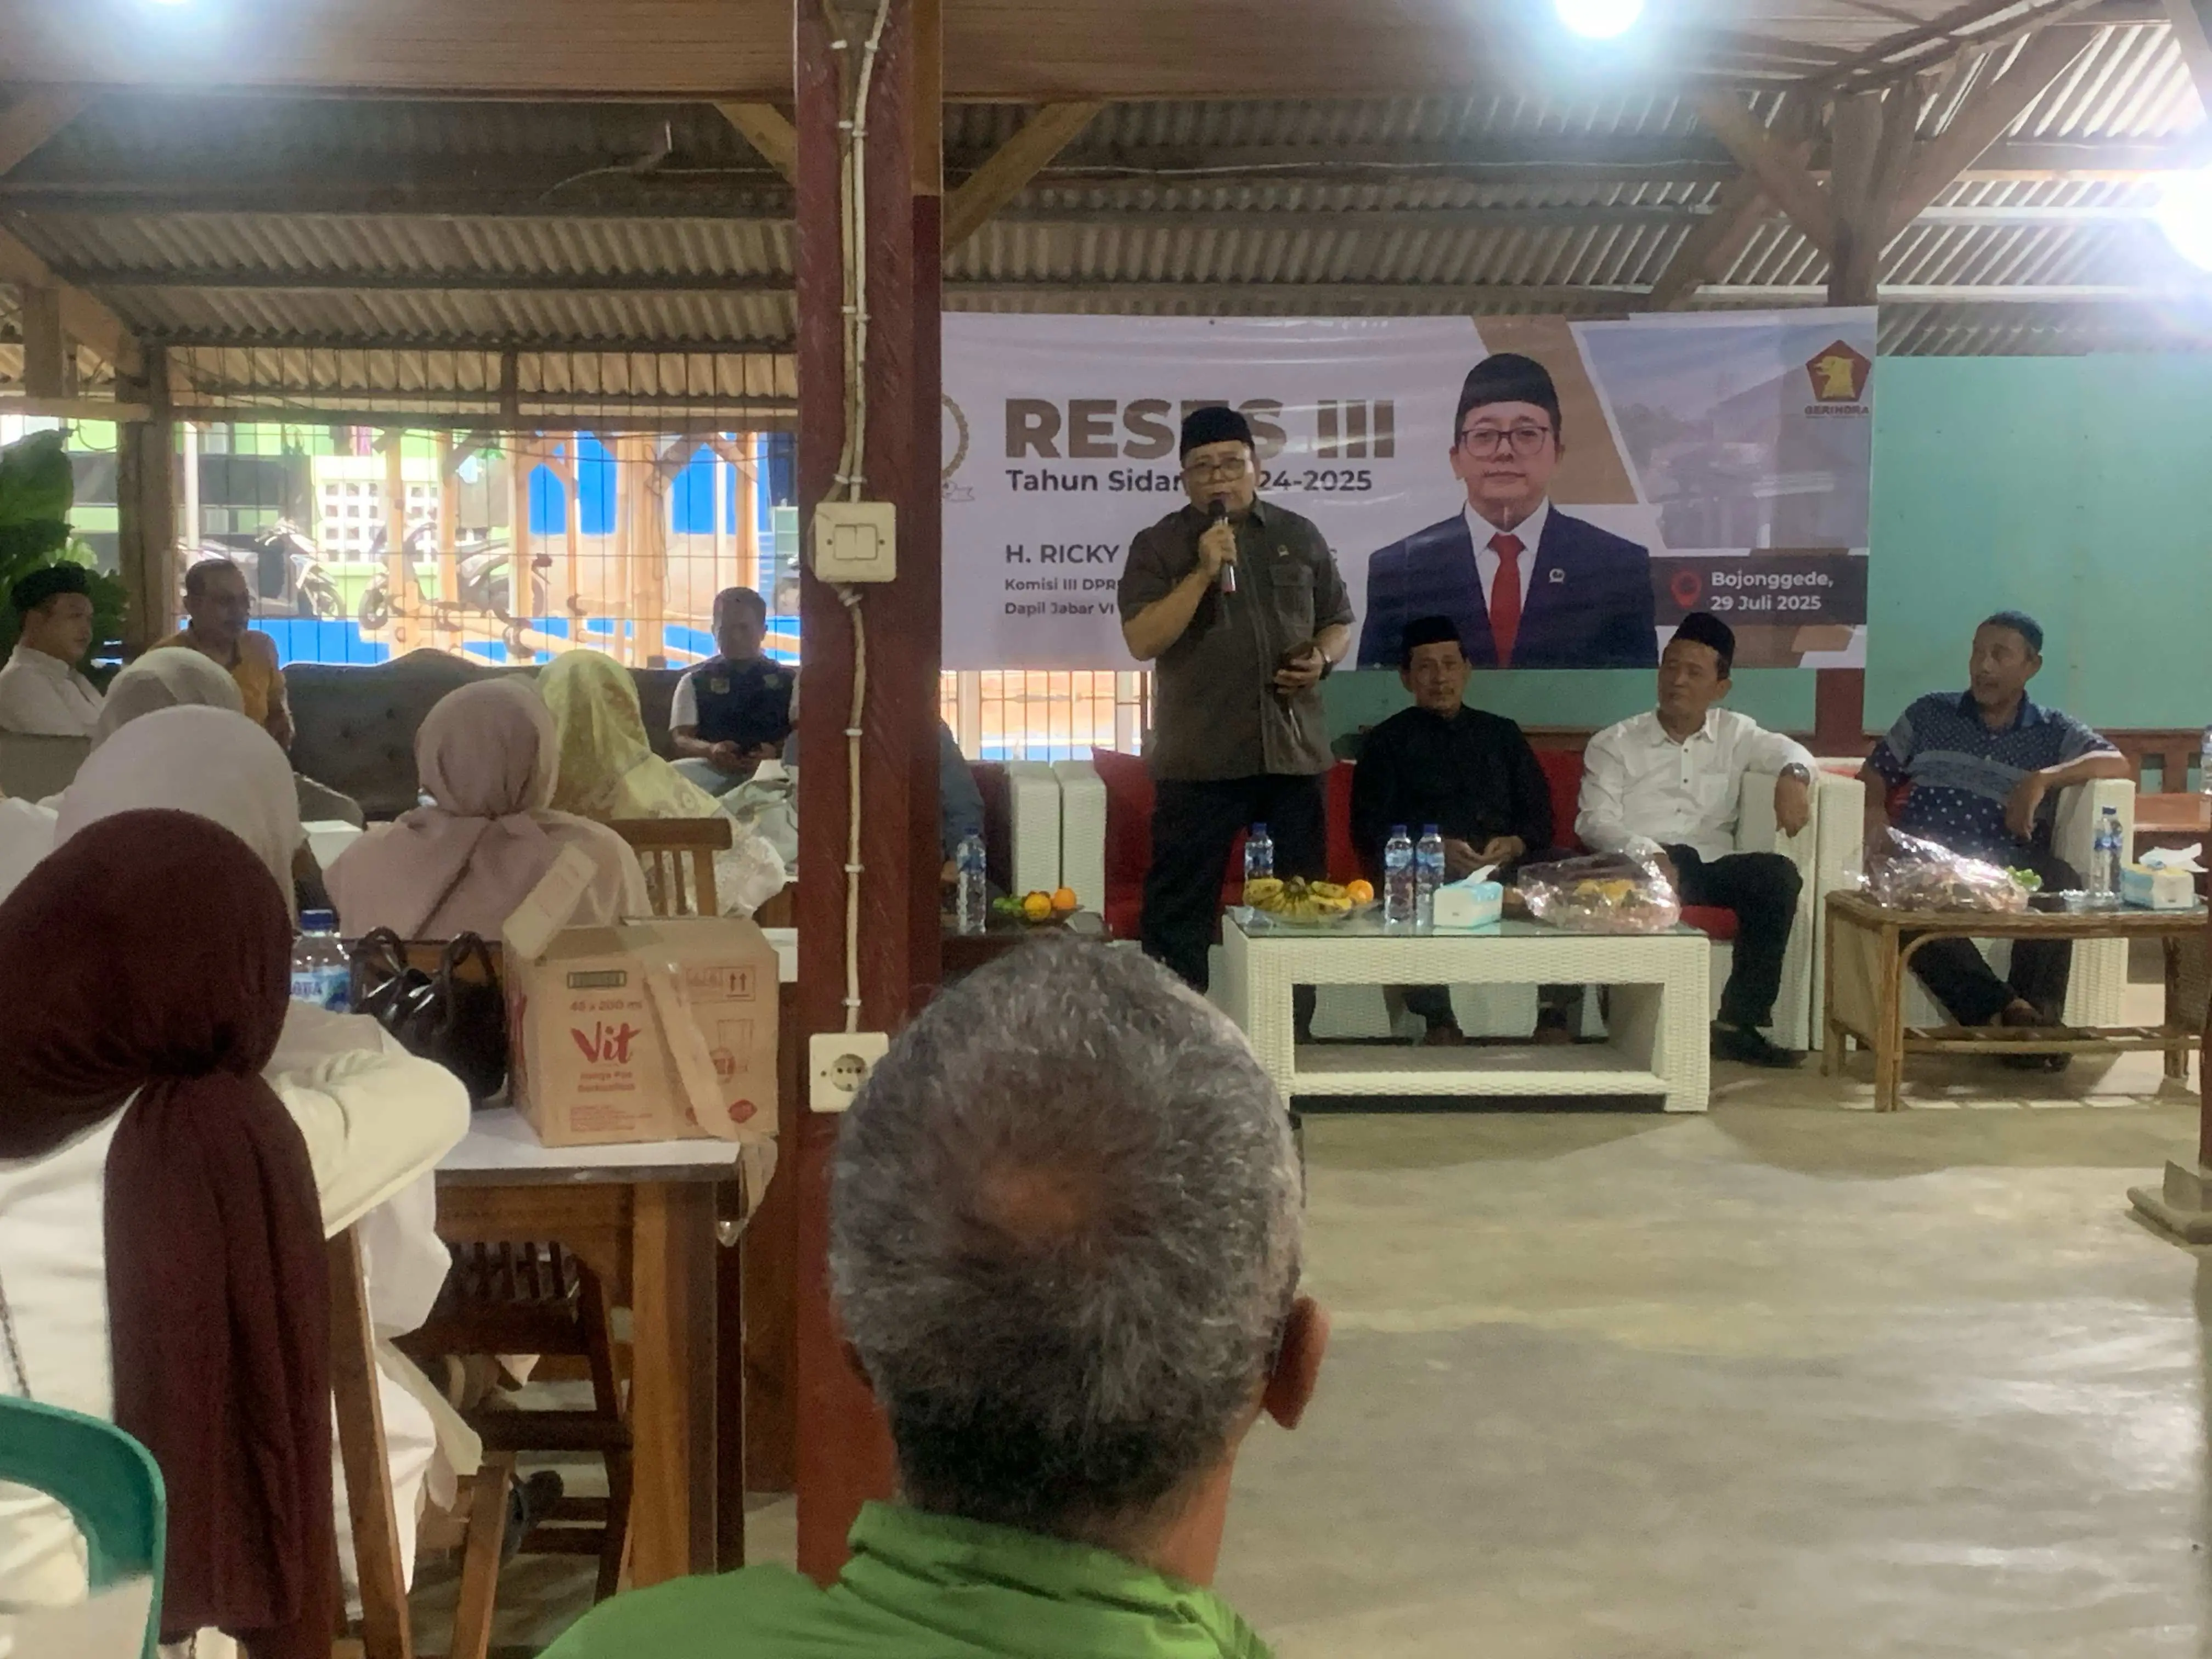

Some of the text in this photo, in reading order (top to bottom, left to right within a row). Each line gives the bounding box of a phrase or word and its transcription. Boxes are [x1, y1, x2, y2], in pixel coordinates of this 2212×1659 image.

[1804, 405, 1869, 415] GERINDRA
[1317, 399, 1395, 459] III
[1005, 467, 1373, 492] Tahun Sida 24-2025
[1006, 544, 1120, 563] H. RICKY
[1005, 577, 1058, 590] Komisi
[1063, 578, 1077, 590] III
[1711, 568, 1834, 590] Bojonggede,
[1005, 602, 1114, 617] Dapil Jabar VI
[1709, 594, 1822, 611] 29 Juli 2025
[571, 1021, 641, 1064] Vit
